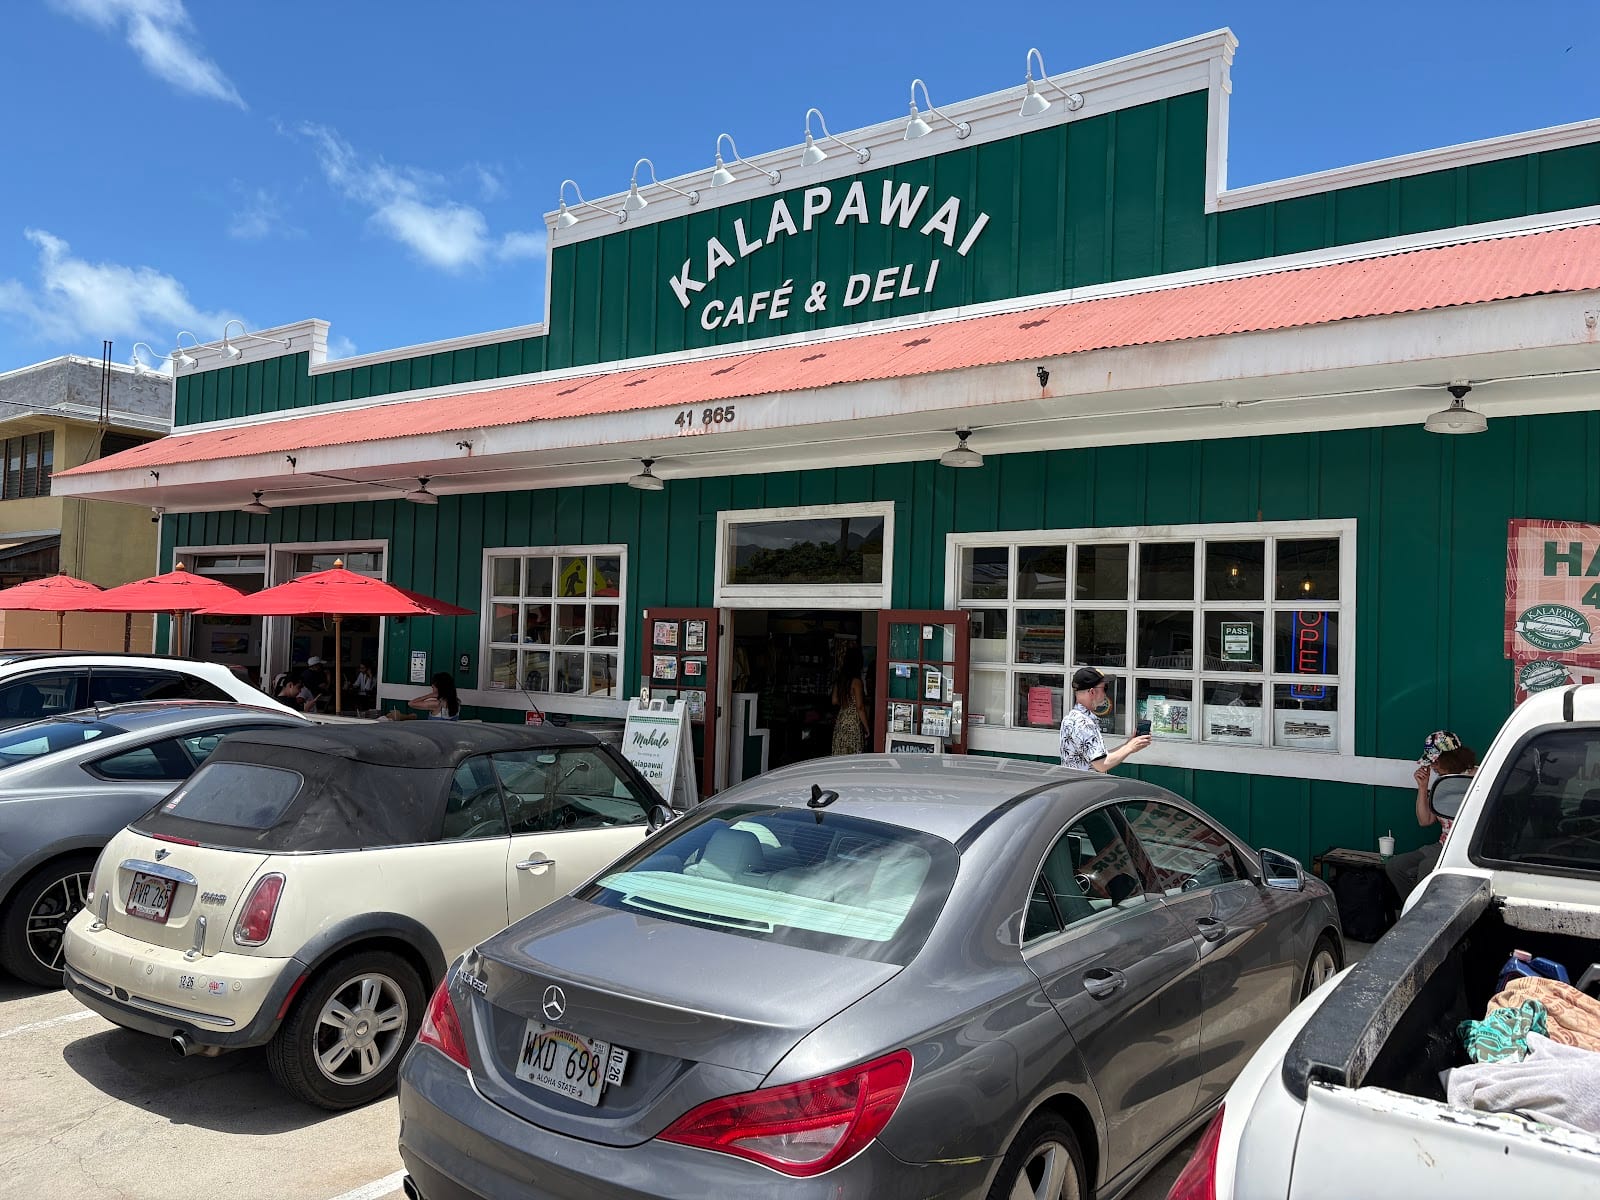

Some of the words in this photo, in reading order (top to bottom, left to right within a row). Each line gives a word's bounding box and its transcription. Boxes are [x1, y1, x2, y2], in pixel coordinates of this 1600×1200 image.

[669, 179, 990, 309] KALAPAWAI
[700, 279, 793, 330] CAFÉ
[804, 281, 827, 313] &
[843, 259, 940, 307] DELI
[674, 410, 693, 428] 41
[702, 405, 735, 425] 865
[1527, 607, 1584, 627] KALAPAWAI
[1226, 627, 1248, 635] PASS
[1526, 632, 1551, 648] MARKET
[632, 728, 669, 749] Mahalo
[649, 770, 663, 779] Deli
[133, 881, 151, 904] TVR
[151, 886, 171, 910] 265
[523, 1031, 558, 1072] WXD
[565, 1048, 600, 1087] 698
[536, 1073, 557, 1087] ALOHA
[557, 1080, 577, 1095] STATE
